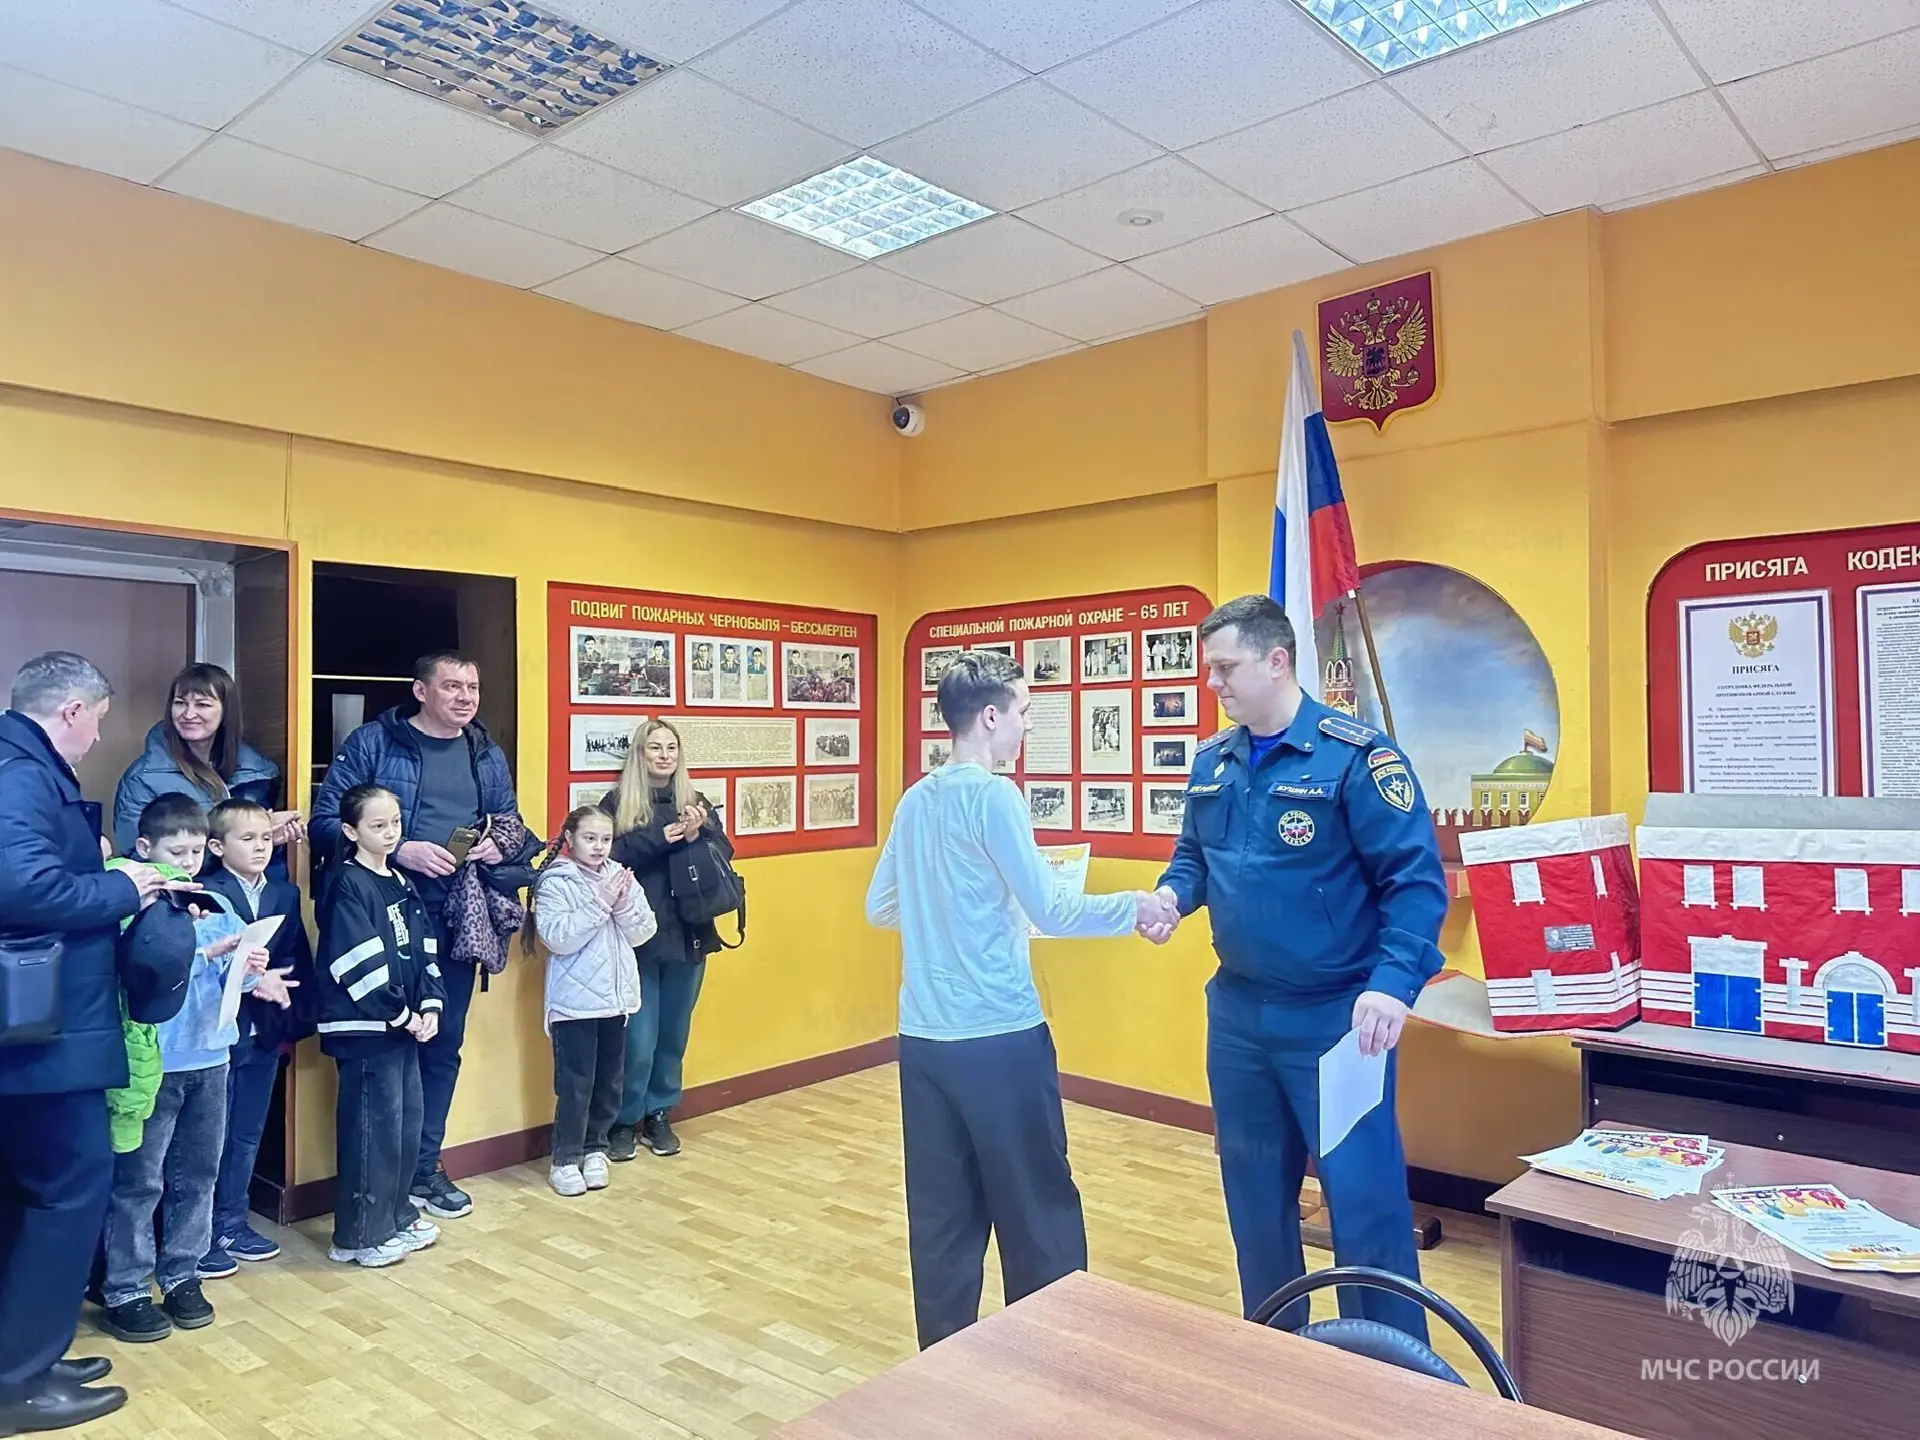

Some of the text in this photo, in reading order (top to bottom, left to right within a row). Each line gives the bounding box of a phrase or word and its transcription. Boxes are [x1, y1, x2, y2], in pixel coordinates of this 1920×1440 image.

[1705, 556, 1809, 582] ПРИСЯГА
[570, 599, 628, 619] ПОДВИГ
[632, 605, 705, 626] ПОЖАРНЫХ
[709, 613, 780, 632] ЧЕРНОБЫЛЯ
[791, 621, 858, 638] БЕССМЕРТЕН
[929, 616, 1004, 638] СПЕЦИАЛЬНОЙ
[1009, 608, 1073, 632] ПОЖАРНОЙ
[1078, 607, 1124, 625] ОХРАНЕ
[1140, 604, 1158, 620] 65
[1163, 601, 1189, 618] ЛЕТ
[1732, 664, 1780, 674] ПРИСЯГА
